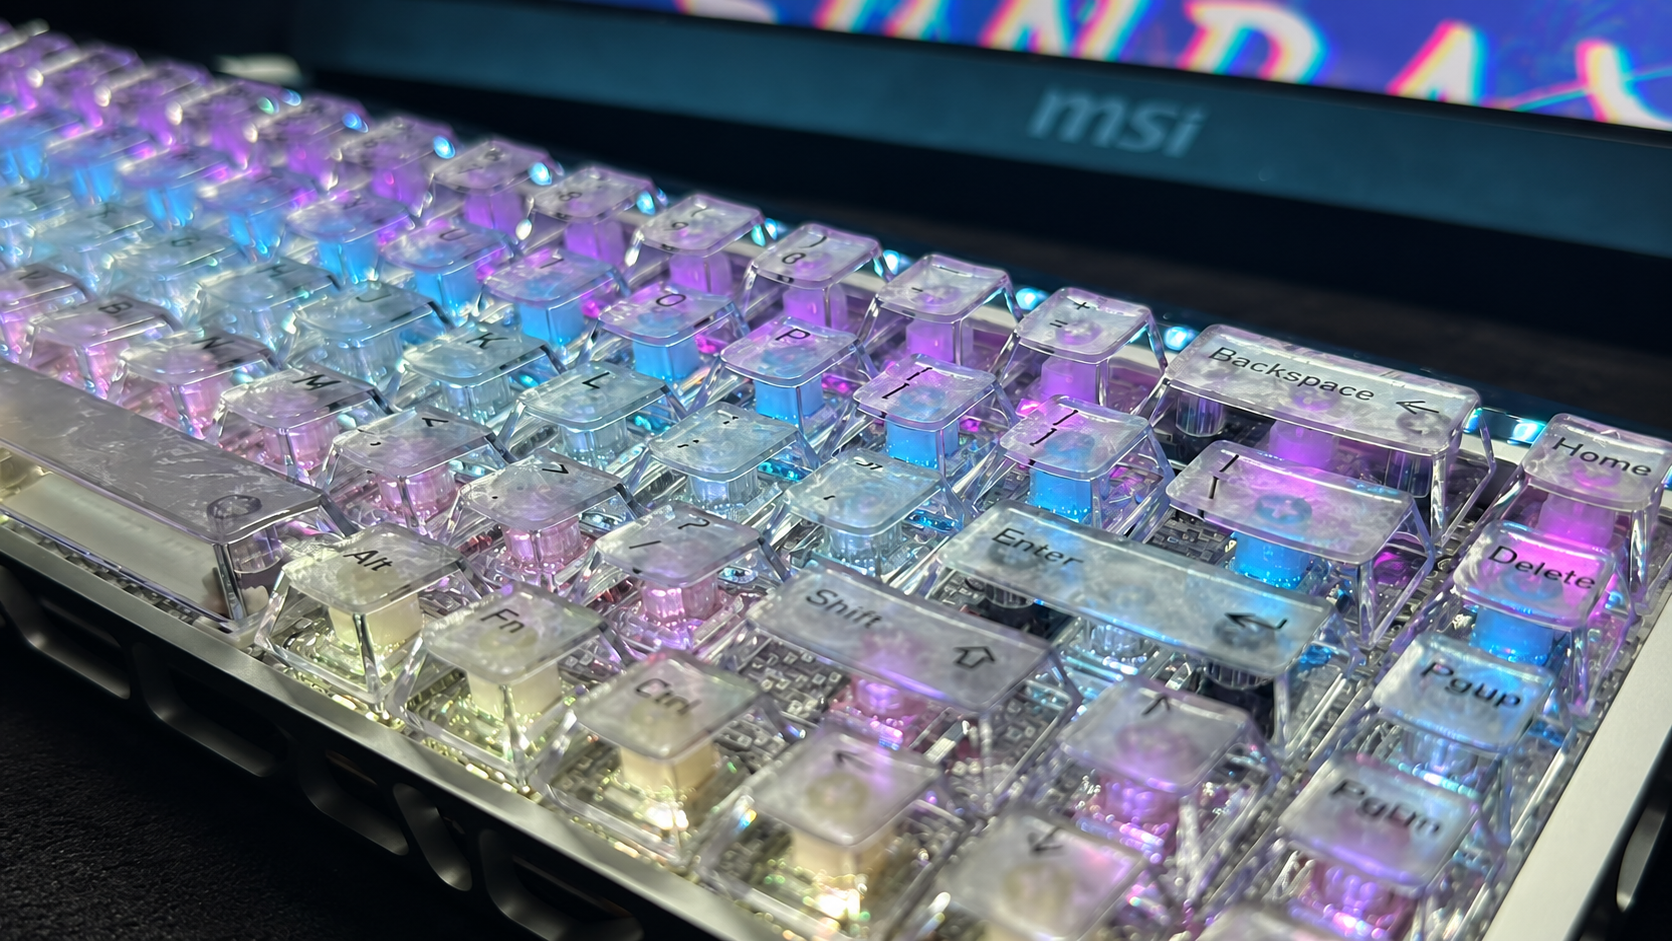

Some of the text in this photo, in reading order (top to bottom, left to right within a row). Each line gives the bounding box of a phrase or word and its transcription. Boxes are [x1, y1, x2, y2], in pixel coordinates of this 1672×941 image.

[1028, 88, 1208, 158] msi
[1073, 300, 1091, 312] +
[463, 331, 509, 350] K
[773, 327, 812, 342] P
[292, 373, 342, 392] M
[581, 371, 610, 390] L
[1207, 345, 1376, 403] Backspace
[1552, 435, 1653, 477] Home
[342, 549, 394, 572] Alt
[991, 526, 1085, 567] Enter
[1487, 544, 1597, 590] Delete
[480, 607, 526, 634] Fn
[804, 588, 883, 630] Shift
[635, 677, 702, 716] Ctrl
